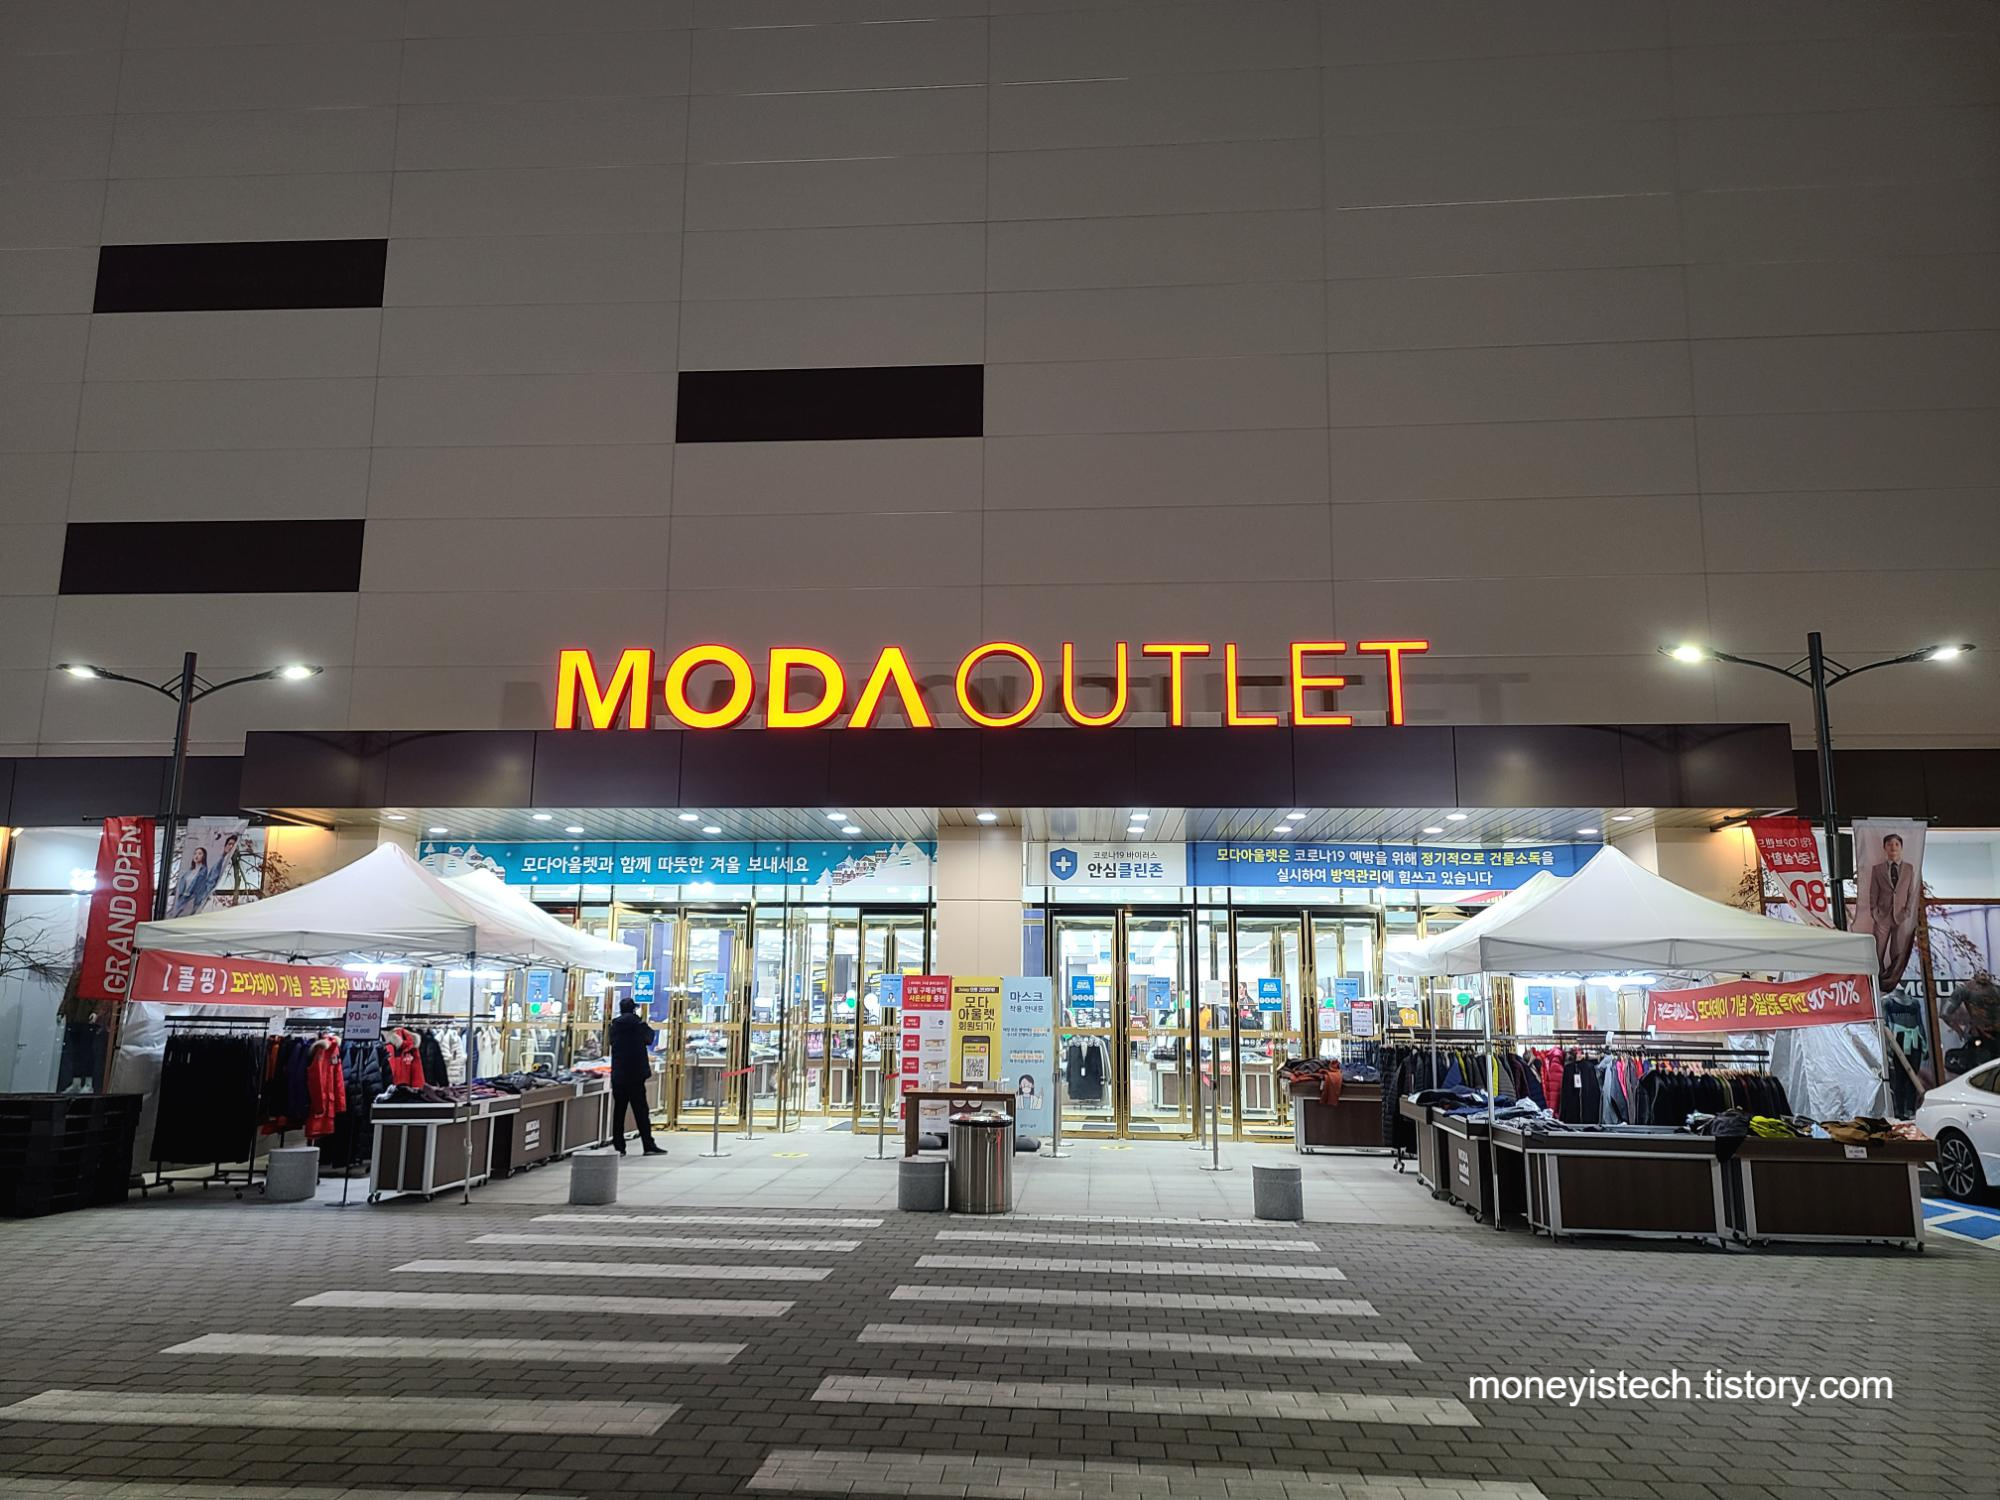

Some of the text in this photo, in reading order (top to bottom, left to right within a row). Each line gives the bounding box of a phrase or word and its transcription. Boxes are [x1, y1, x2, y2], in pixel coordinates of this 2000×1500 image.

[554, 640, 1429, 730] MODA OUTLET
[1093, 850, 1158, 860] 코로나19 바이러스
[1217, 847, 1554, 867] 모다아울렛은 코로나19 예방을 위해 정기적으로 건물소독을
[521, 856, 809, 875] 모다아울렛과 함께 따뜻한 겨울 보내세요
[1087, 860, 1164, 879] 안심클린존
[1277, 868, 1493, 887] 실시하여 방역관리에 힘쓰고 있습니다
[103, 824, 142, 994] GRAND OPEN
[230, 971, 278, 997] 모다데이
[282, 972, 302, 997] 기념
[965, 995, 989, 1008] 모다
[1010, 991, 1044, 1003] 마스크
[958, 1008, 995, 1021] 아울렛
[1024, 1005, 1044, 1013] 안내문
[1699, 996, 1729, 1020] 모다데이
[1730, 994, 1748, 1017] 기념
[958, 1021, 995, 1031] 회원되기!
